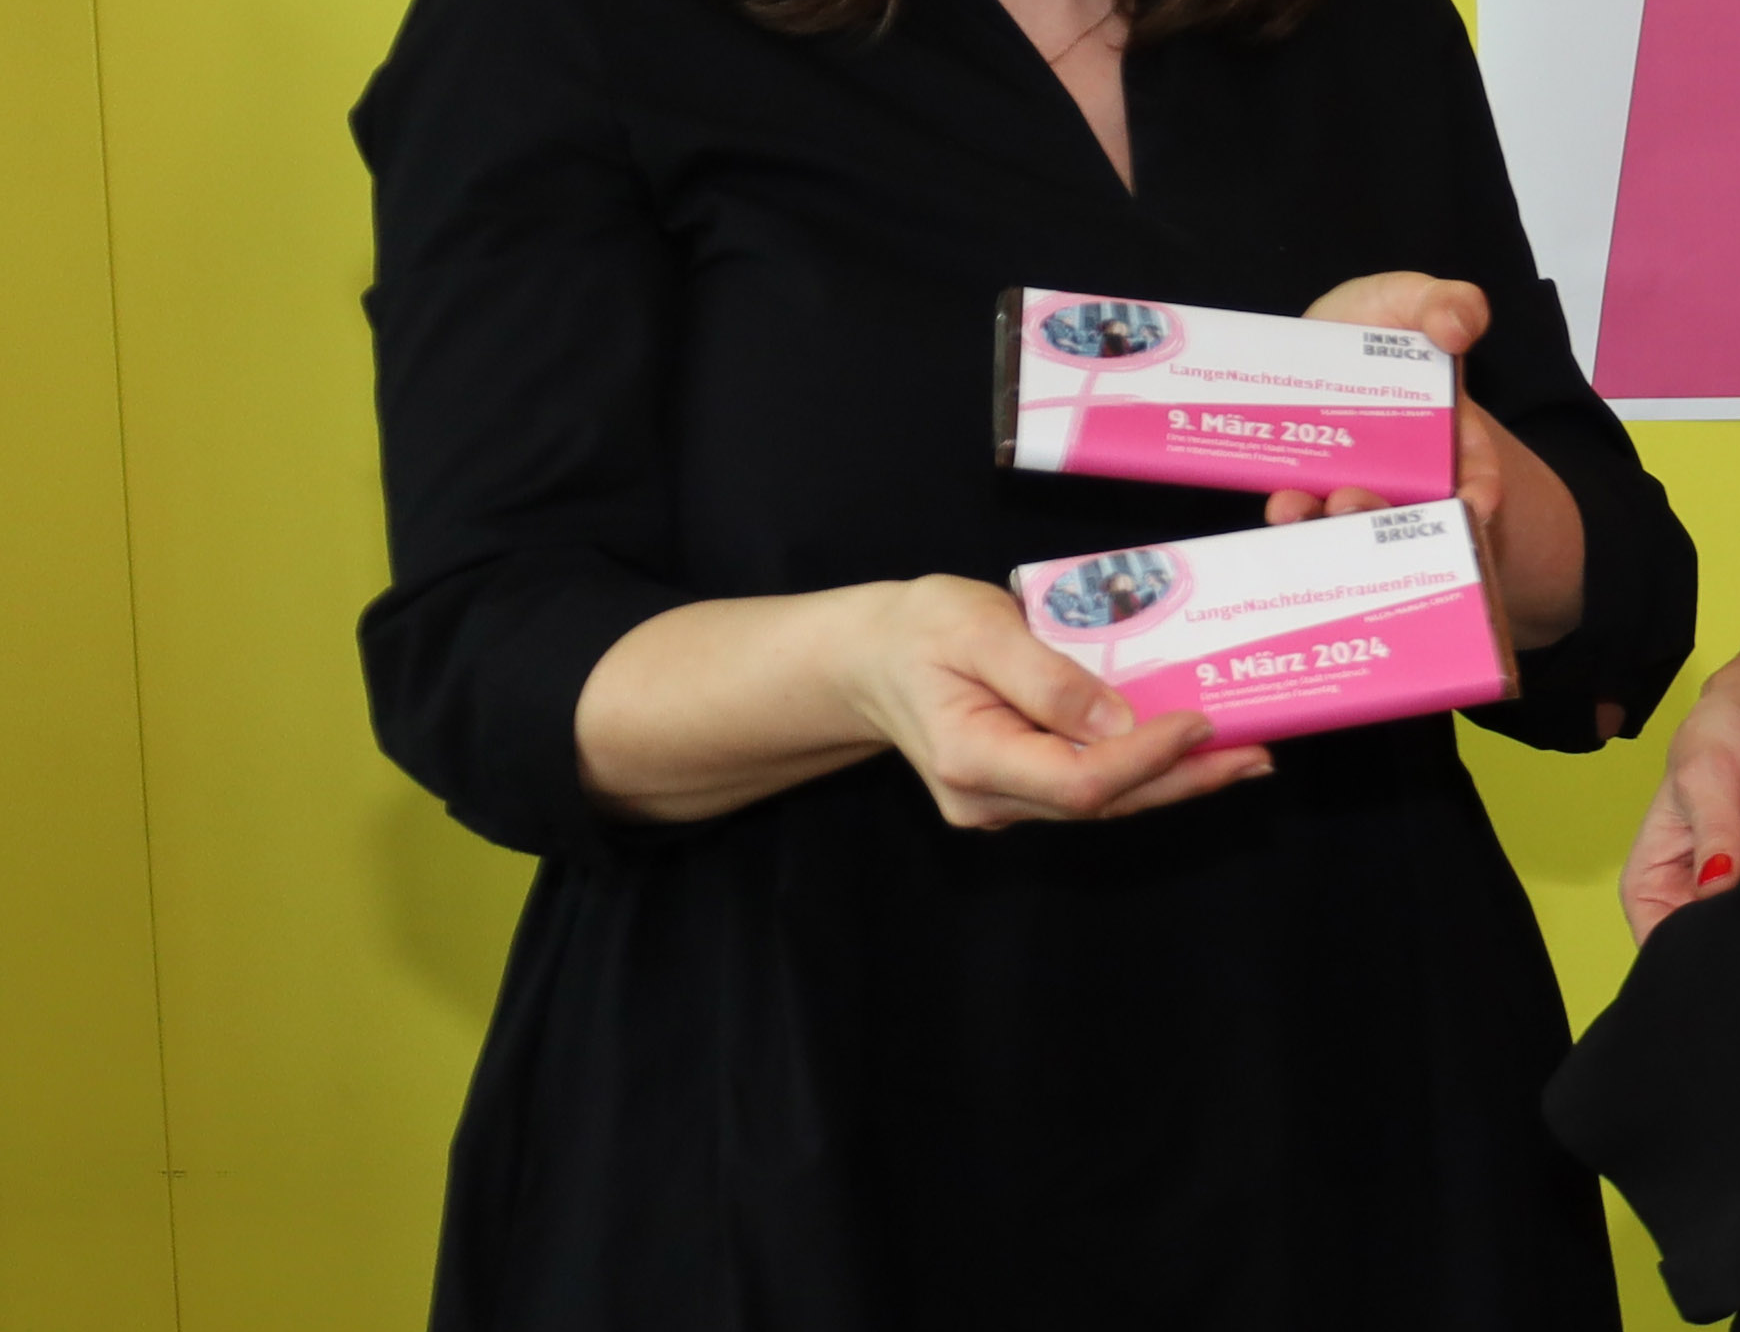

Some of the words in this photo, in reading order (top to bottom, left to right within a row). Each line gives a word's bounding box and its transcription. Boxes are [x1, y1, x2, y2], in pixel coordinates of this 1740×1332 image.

[1362, 344, 1433, 362] BRUCK
[1168, 409, 1196, 431] 9.
[1201, 413, 1276, 439] März
[1280, 421, 1355, 448] 2024
[1374, 522, 1448, 544] BRUCK
[1195, 662, 1227, 687] 9.
[1230, 651, 1308, 681] März
[1312, 637, 1390, 668] 2024
